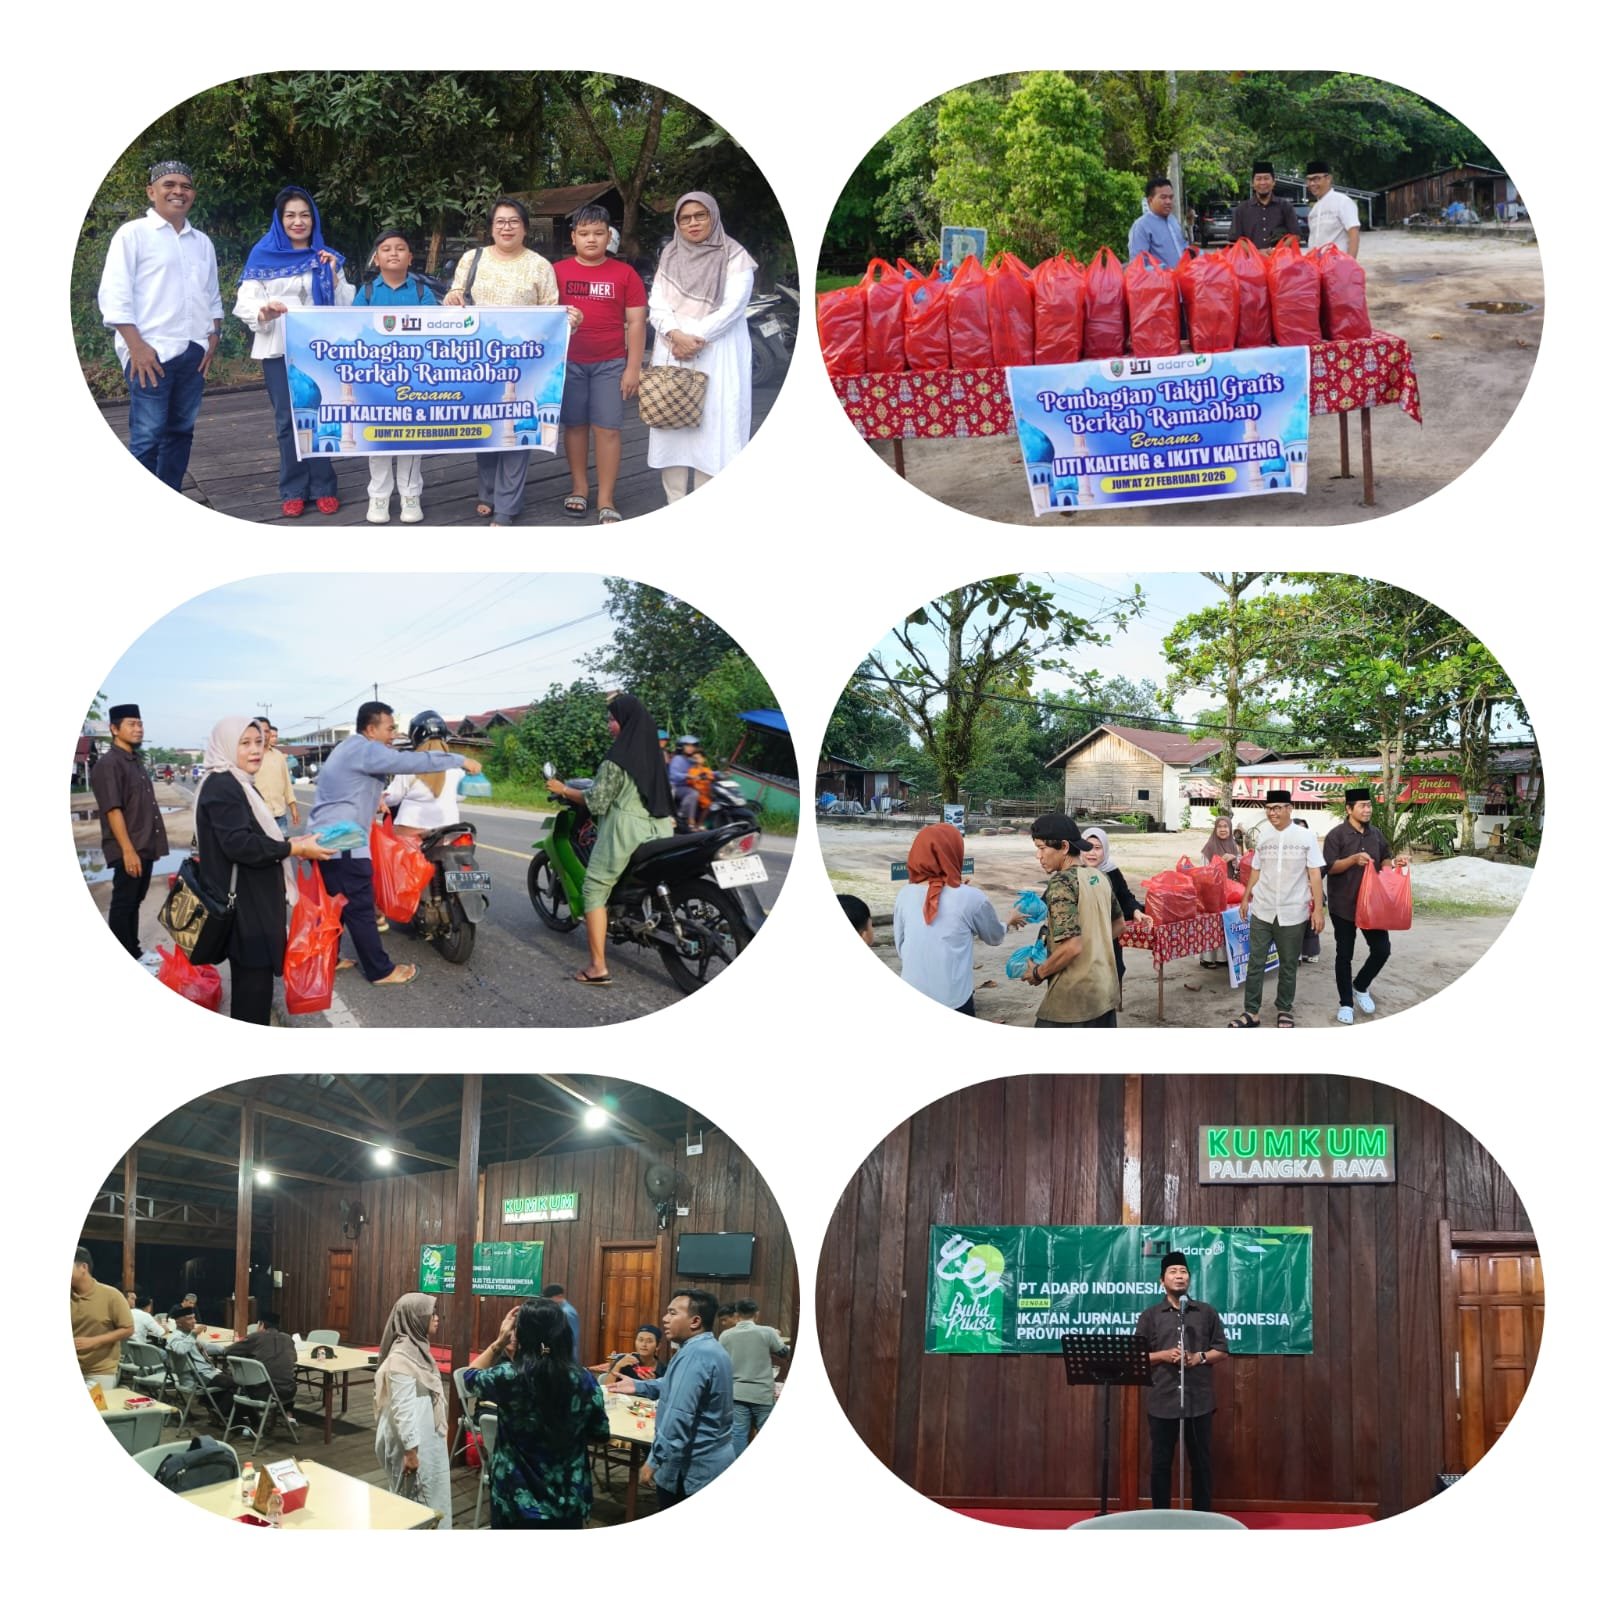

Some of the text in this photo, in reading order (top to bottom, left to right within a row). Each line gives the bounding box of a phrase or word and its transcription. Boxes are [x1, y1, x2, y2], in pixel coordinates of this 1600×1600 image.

[567, 282, 611, 296] SUMMER
[427, 319, 463, 329] adaro
[312, 339, 542, 362] Pembagian Takjil Gratis
[336, 363, 520, 384] Berkah Ramadhan
[1157, 359, 1194, 370] adaro
[396, 386, 463, 400] Bersama
[1039, 374, 1283, 411] Pembagian Takjil Gratis
[321, 402, 532, 422] IJTI KALTENG & IKJTV KALTENG
[1066, 402, 1260, 434] Berkah Ramadhan
[374, 427, 482, 438] JUM'AT 27 FEBRUARI 2026
[1131, 432, 1201, 448] Bersama
[1055, 441, 1278, 476] IJTI KALTENG & IKJTV KALTENG
[1112, 471, 1226, 489] JUM'AT 27 FEBRUARI 2026
[1418, 778, 1451, 789] Aneka
[1208, 1128, 1386, 1158] KUMKUM
[1209, 1159, 1387, 1178] PALANGKA RAYA
[504, 1194, 575, 1214] KUMKUM
[1019, 1282, 1167, 1294] PT ADARO INDONESIA
[948, 1291, 989, 1317] Buka
[943, 1314, 996, 1338] Puasa
[1017, 1312, 1069, 1324] IKATAN
[1218, 1313, 1290, 1326] NDONESIA
